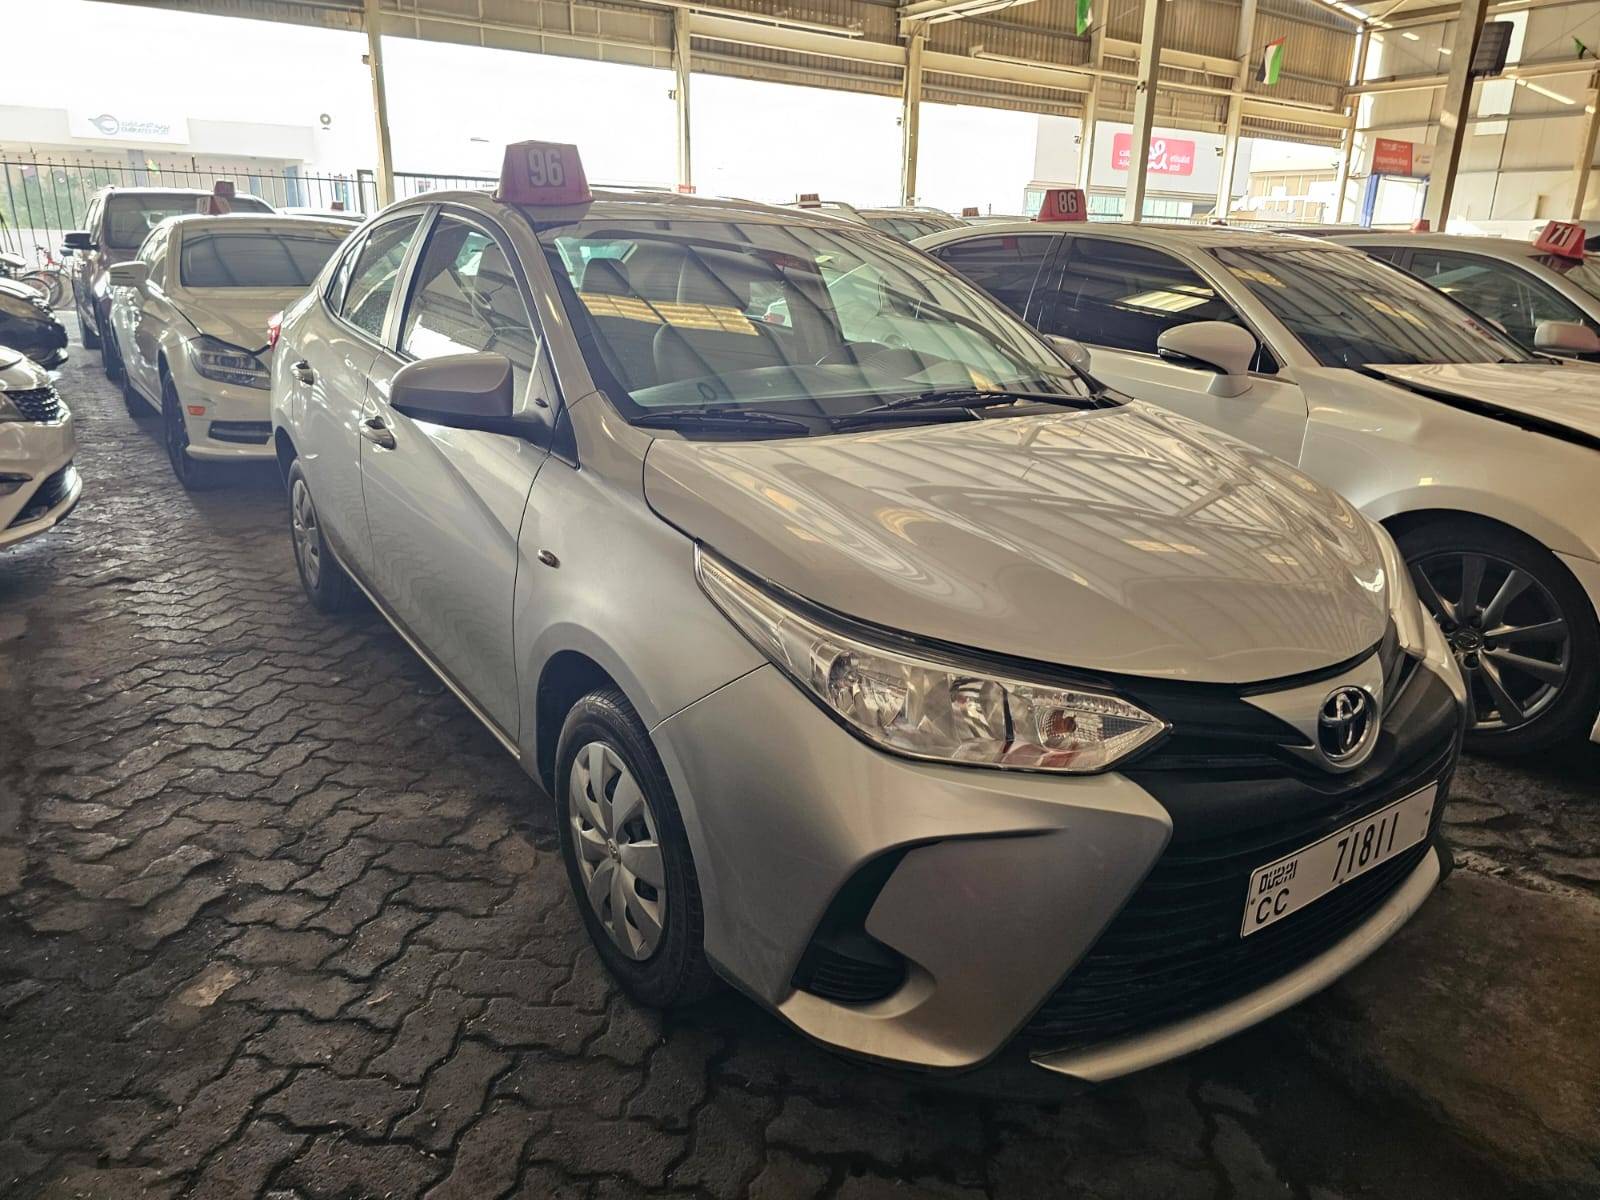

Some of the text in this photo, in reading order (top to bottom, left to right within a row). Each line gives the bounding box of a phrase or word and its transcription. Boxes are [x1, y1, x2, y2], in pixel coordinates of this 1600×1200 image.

[528, 149, 564, 187] 96
[1058, 190, 1077, 213] 86
[1547, 223, 1573, 246] 71
[1332, 812, 1399, 881] 71811
[1255, 888, 1290, 925] CC
